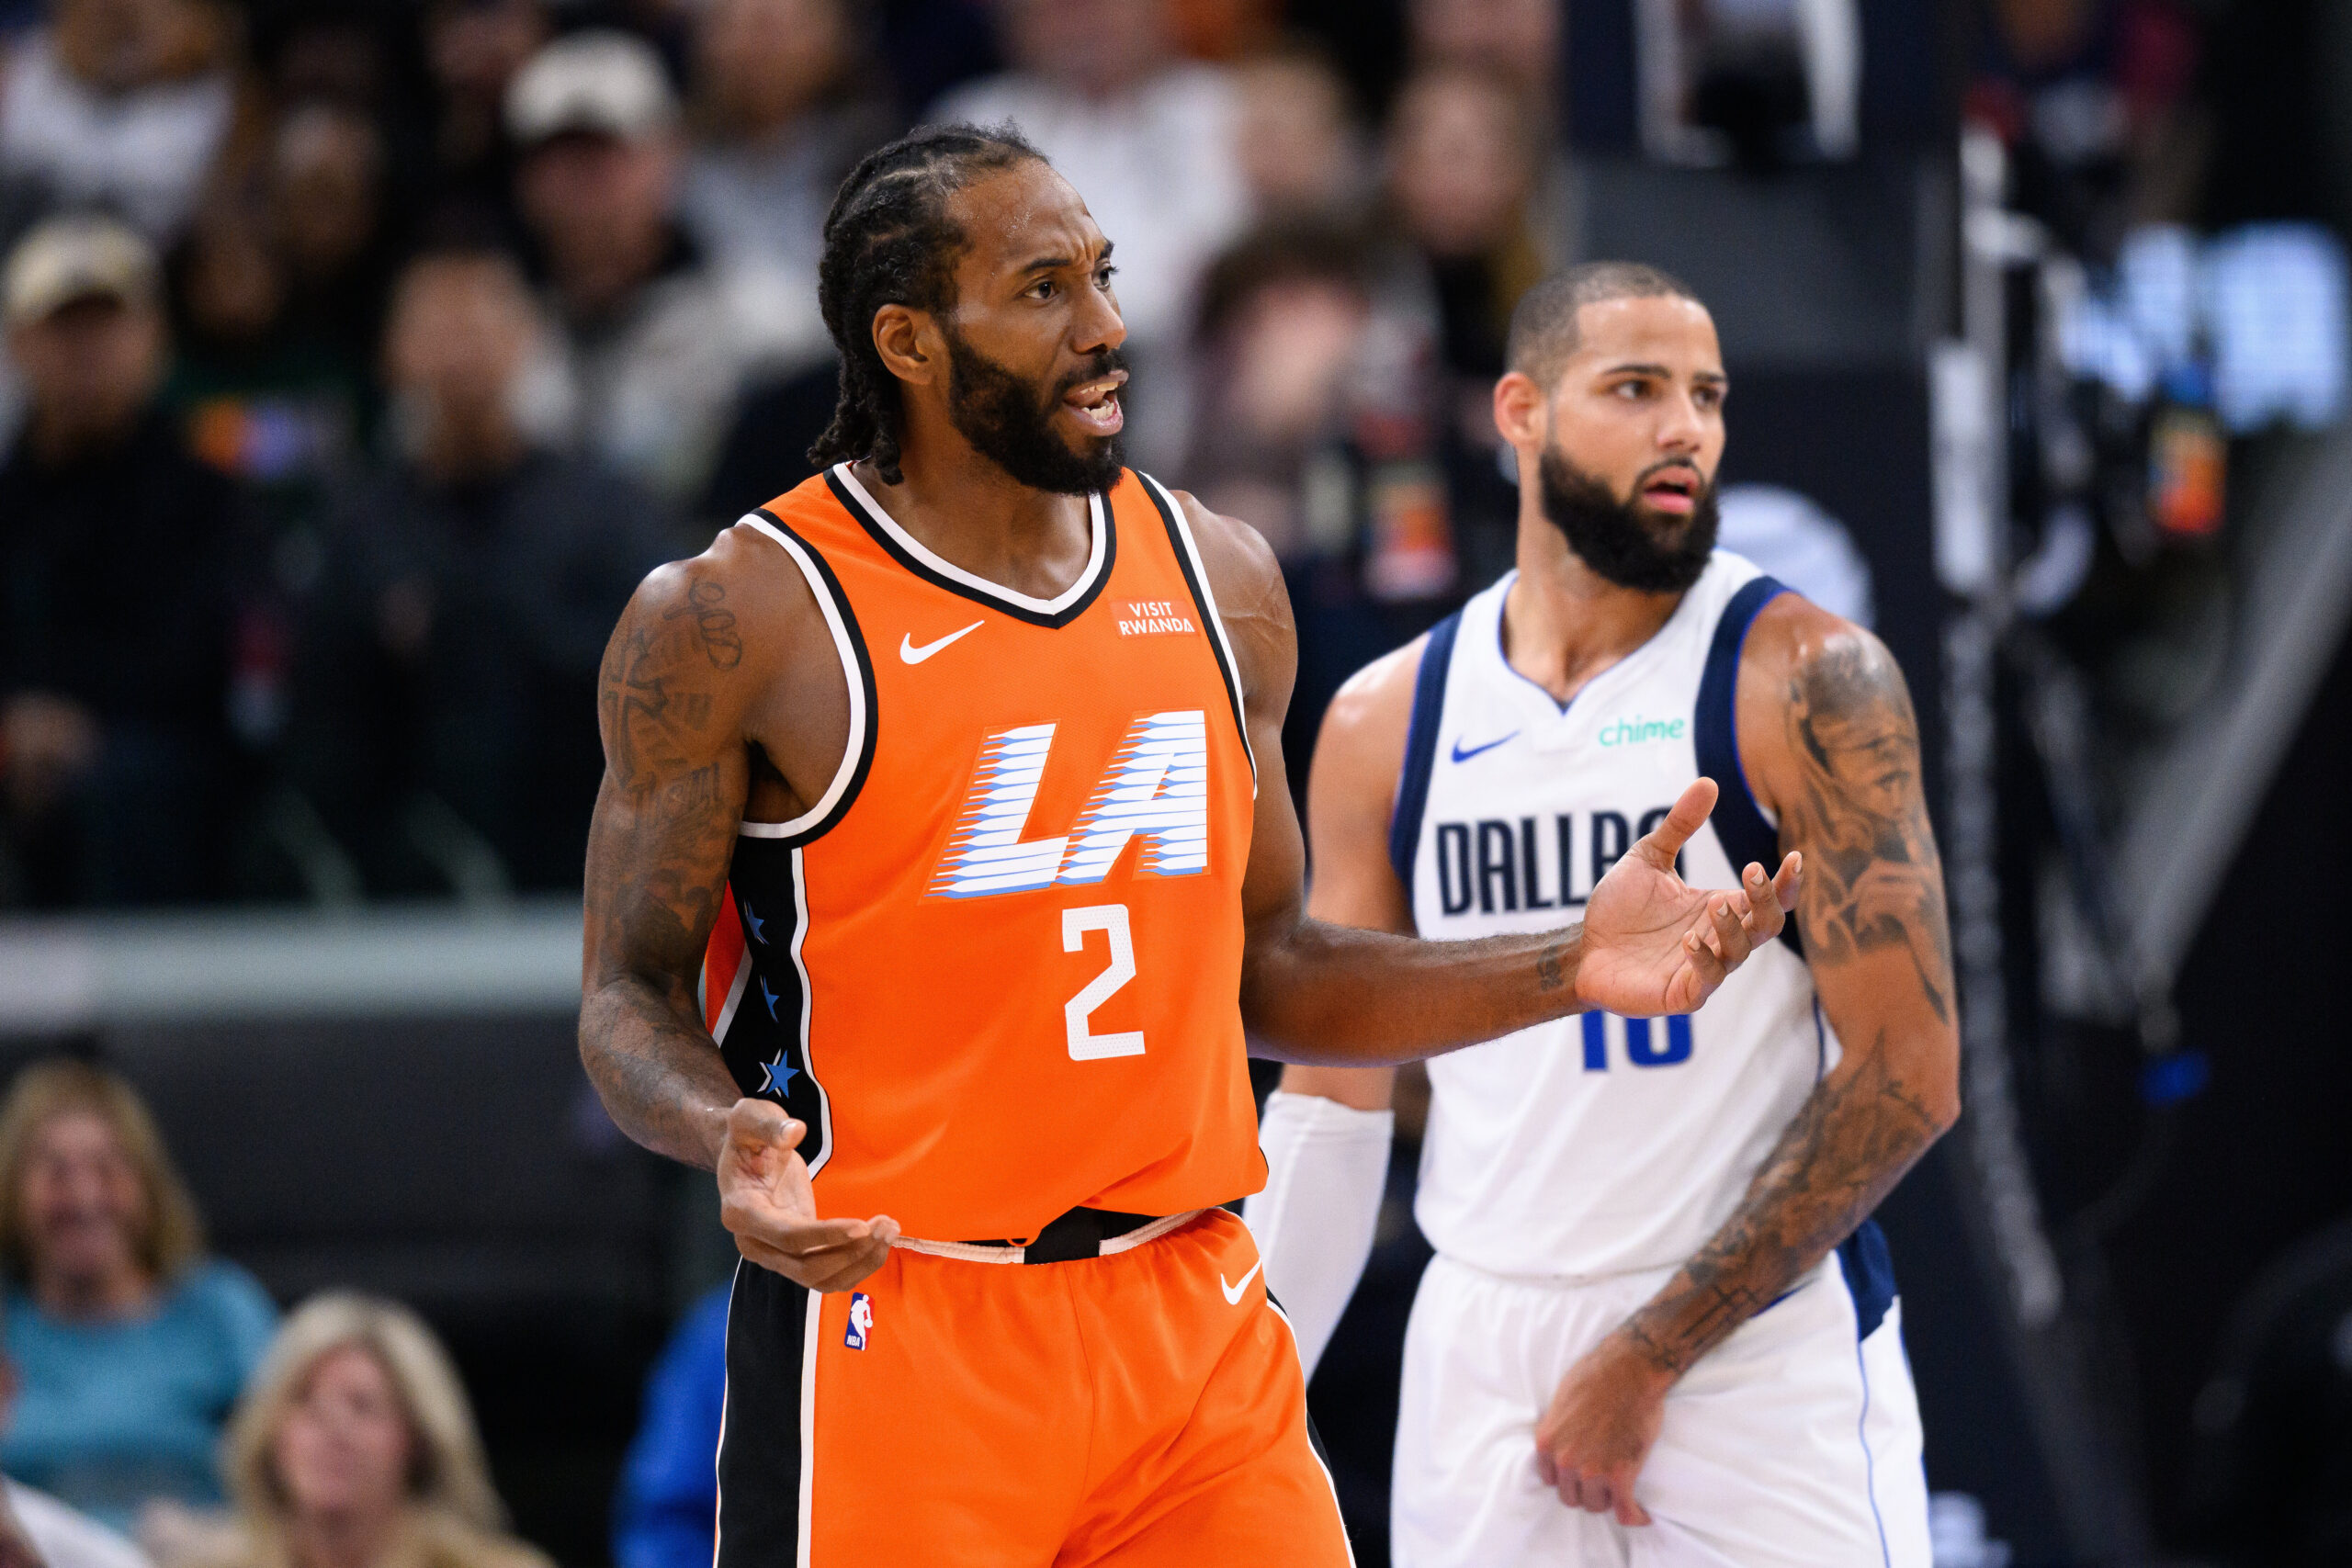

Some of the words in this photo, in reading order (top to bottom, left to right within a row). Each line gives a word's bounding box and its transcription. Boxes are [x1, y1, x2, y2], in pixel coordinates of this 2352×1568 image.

[1128, 602, 1173, 617] VISIT
[1118, 617, 1195, 636] RWANDA
[1599, 715, 1685, 747] chime
[923, 710, 1208, 898] LA
[1062, 904, 1146, 1062] 2
[846, 1334, 861, 1348] NBA
